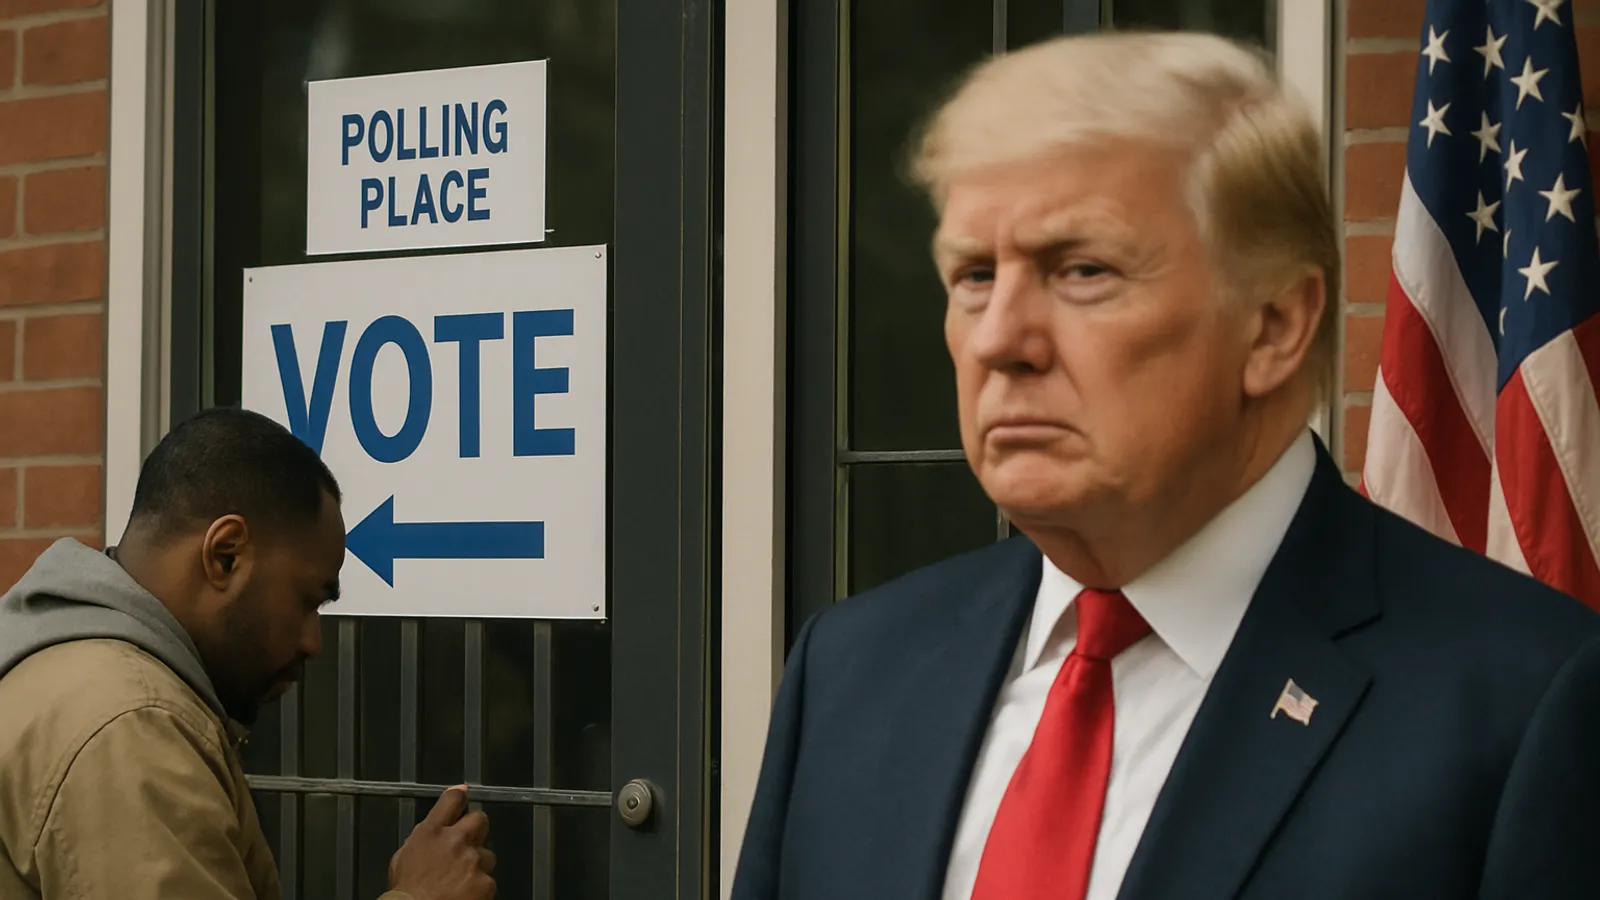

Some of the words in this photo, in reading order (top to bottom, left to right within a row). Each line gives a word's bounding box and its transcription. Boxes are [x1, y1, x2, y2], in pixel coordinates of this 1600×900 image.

[341, 99, 509, 166] POLLING
[361, 169, 491, 228] PLACE
[270, 309, 576, 463] VOTE
